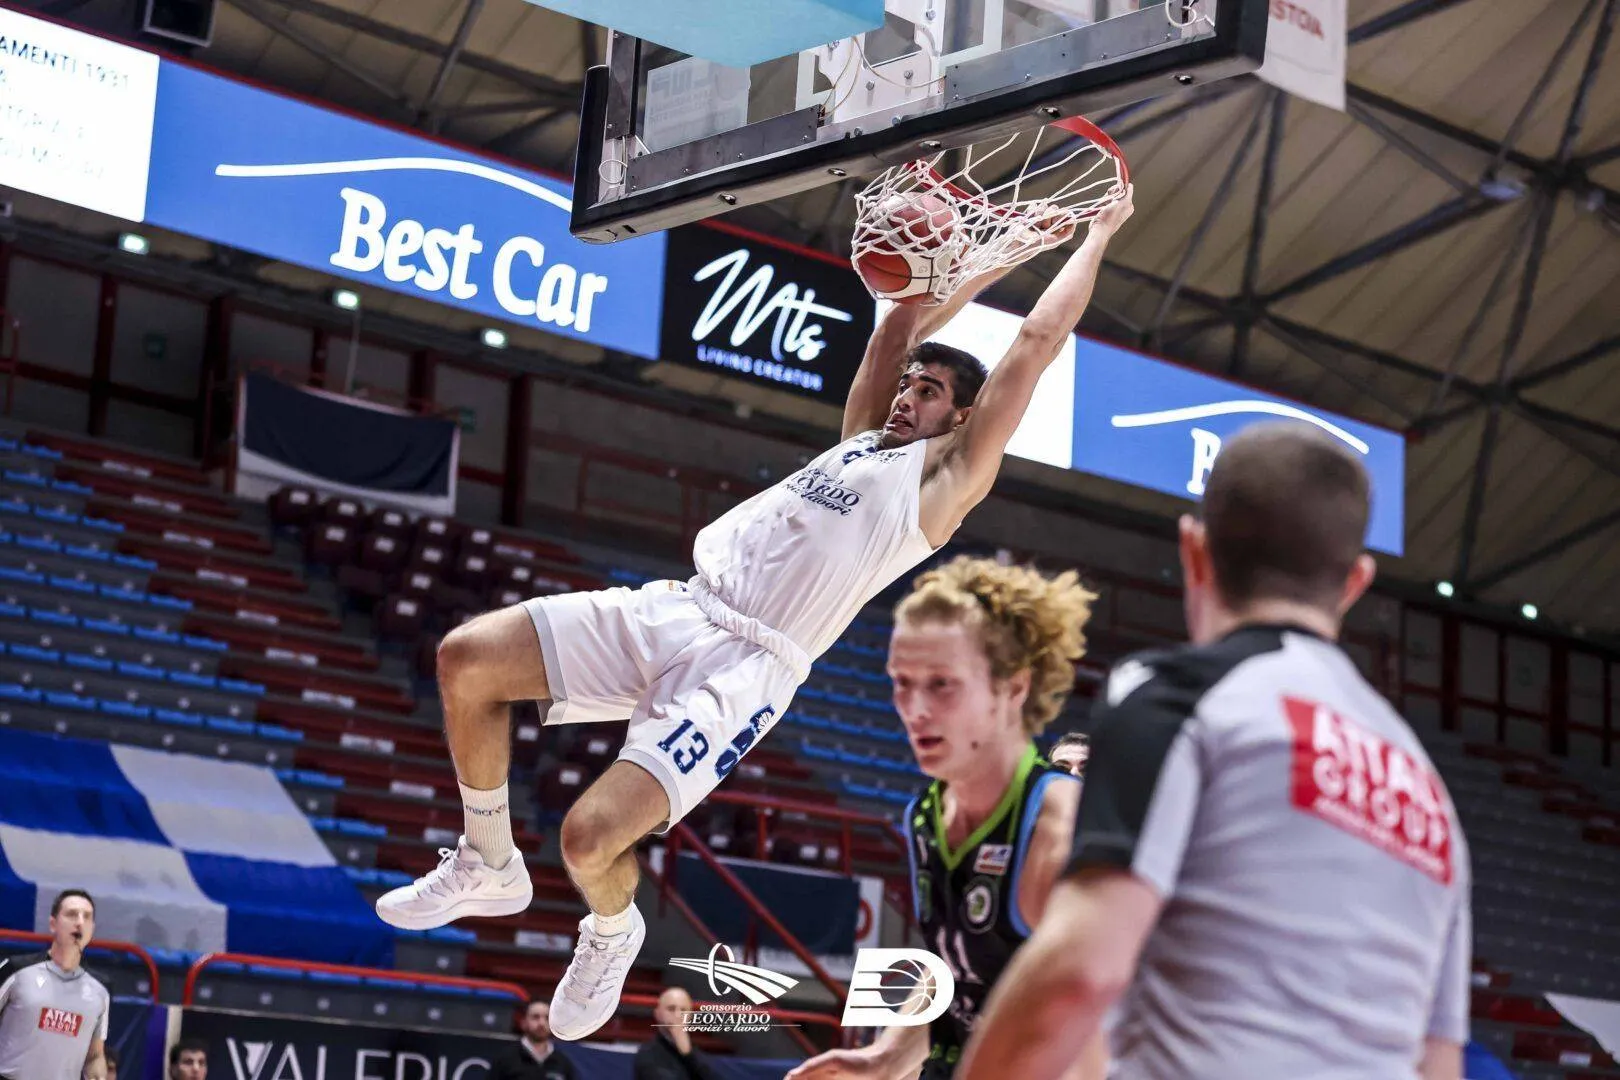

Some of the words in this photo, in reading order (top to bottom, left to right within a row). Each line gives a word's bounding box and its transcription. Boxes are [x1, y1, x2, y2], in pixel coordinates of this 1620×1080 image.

[330, 187, 482, 299] Best
[492, 236, 607, 332] Car
[656, 718, 709, 775] 13
